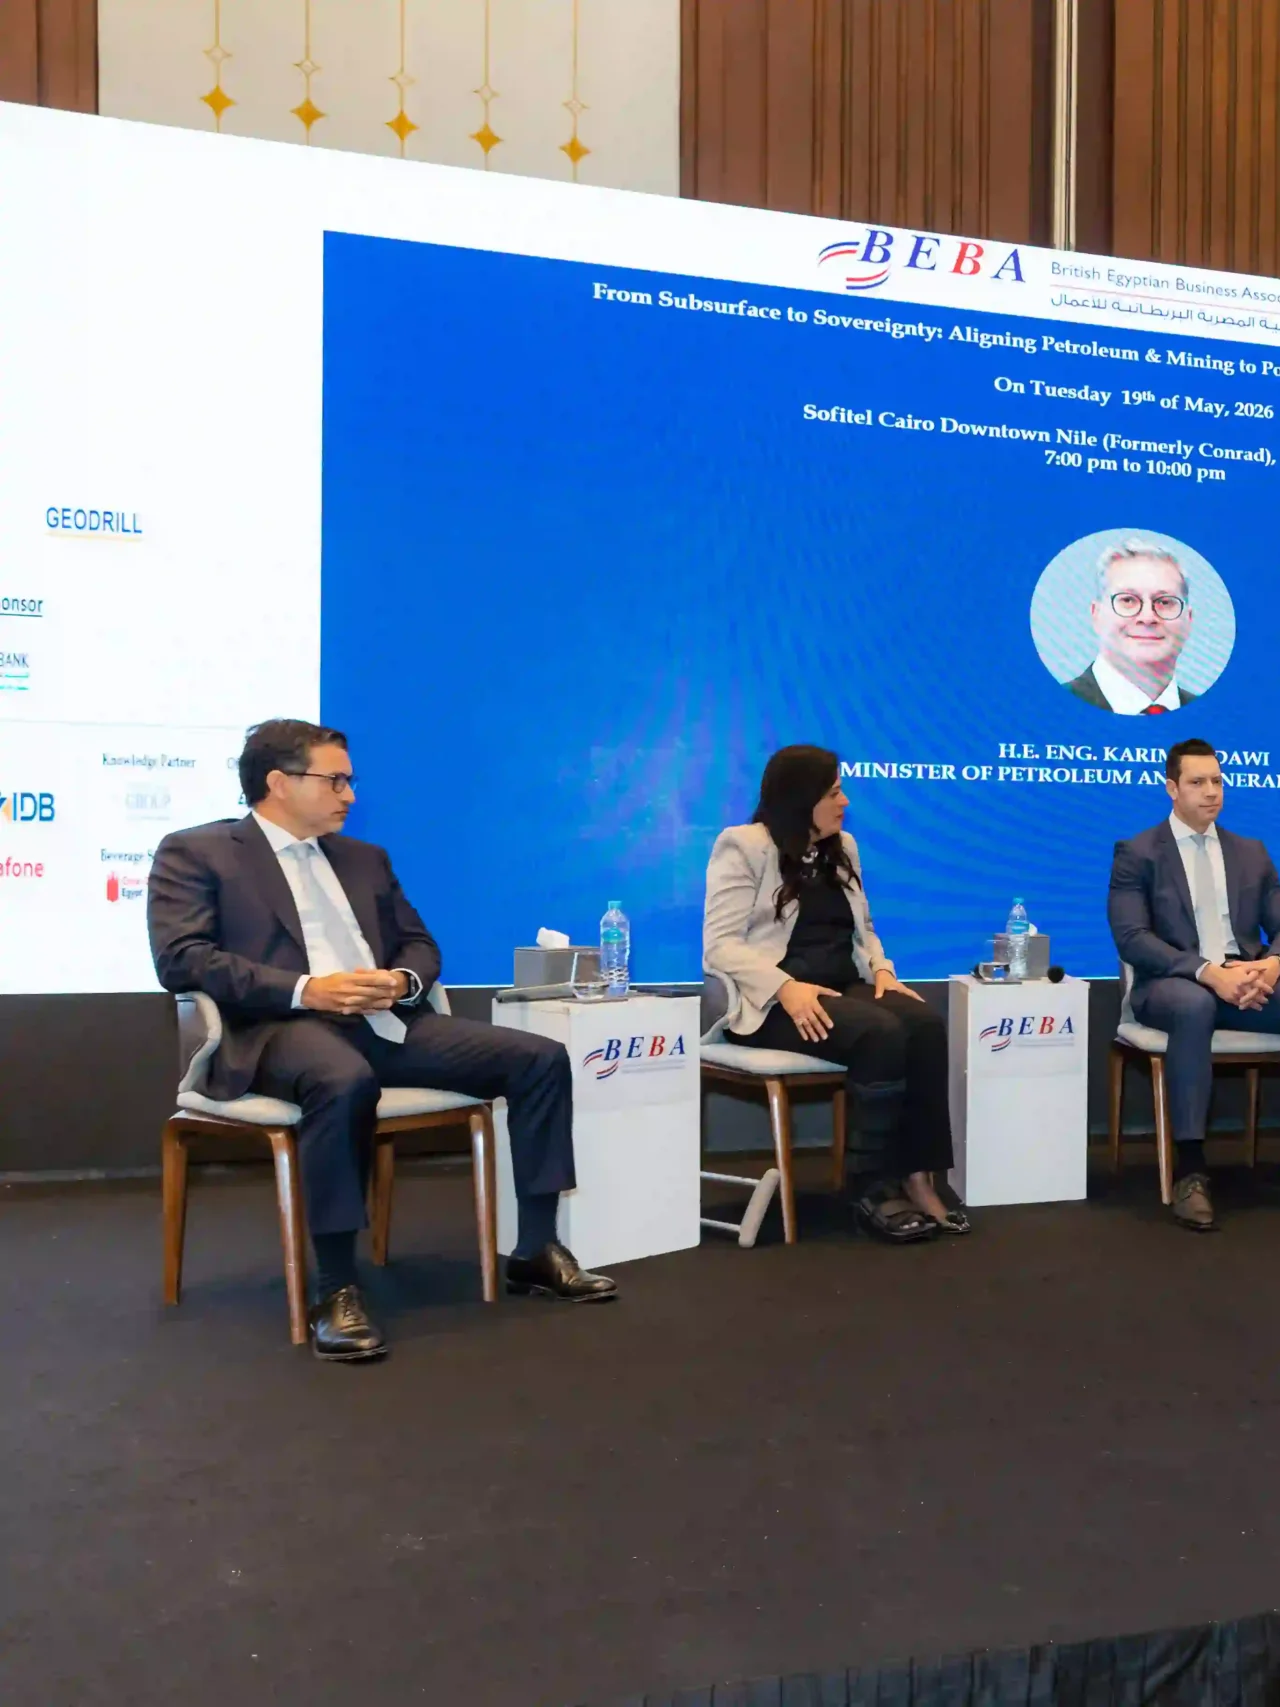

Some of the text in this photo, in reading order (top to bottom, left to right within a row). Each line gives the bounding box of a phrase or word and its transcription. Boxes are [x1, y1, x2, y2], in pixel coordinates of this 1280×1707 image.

[857, 228, 1026, 283] BEBA
[1051, 262, 1100, 280] British
[1107, 268, 1169, 289] Egyptian
[1175, 277, 1237, 298] Business
[592, 282, 652, 305] From
[658, 290, 781, 320] Subsurface
[787, 307, 808, 323] to
[813, 309, 943, 342] Sovereignty:
[948, 325, 1037, 354] Aligning
[1042, 336, 1140, 362] Petroleum
[1145, 348, 1161, 364] &
[1166, 350, 1235, 376] Mining
[1239, 359, 1257, 374] to
[994, 376, 1274, 419] On Tuesday 19th of May, 2026
[803, 404, 873, 426] Sofitel
[878, 412, 935, 432] Cairo
[940, 417, 1051, 443] Downtown
[1056, 428, 1097, 447] Nile
[1102, 433, 1194, 459] (Formerly
[1199, 443, 1276, 466] Conrad),
[1045, 450, 1226, 483] 7:00 pm to 10:00 pm
[46, 507, 142, 534] GEODRILL
[0, 597, 43, 612] onsor
[0, 652, 29, 668] BANK
[998, 743, 1039, 759] H.E.
[1046, 744, 1097, 761] ENG.
[1215, 750, 1270, 766] DAWI
[840, 761, 956, 780] MINISTER
[961, 765, 993, 781] OF
[997, 765, 1132, 784] PETROLEUM
[1137, 770, 1167, 785] AN
[13, 792, 55, 822] IDB
[997, 1016, 1074, 1036] BEBA
[604, 1034, 685, 1060] BEBA
